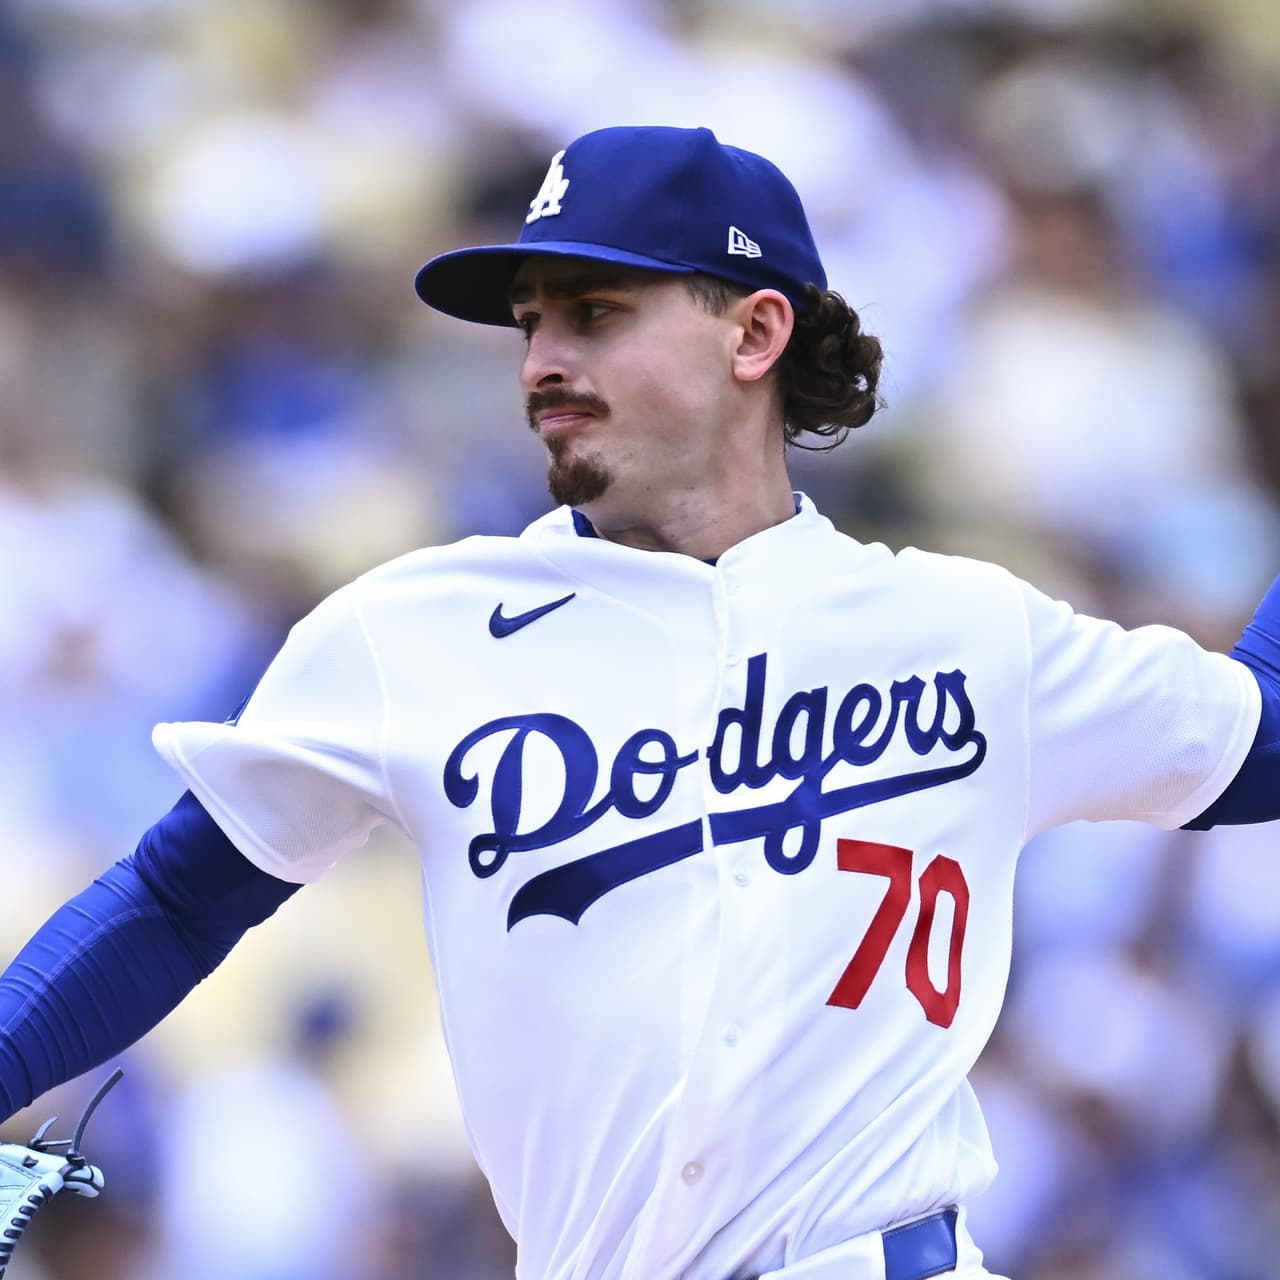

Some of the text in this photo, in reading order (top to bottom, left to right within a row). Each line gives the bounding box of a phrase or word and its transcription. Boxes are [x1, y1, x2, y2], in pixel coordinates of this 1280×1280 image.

[525, 149, 570, 224] LA
[443, 652, 987, 879] Dodgers
[825, 838, 970, 1030] 70
